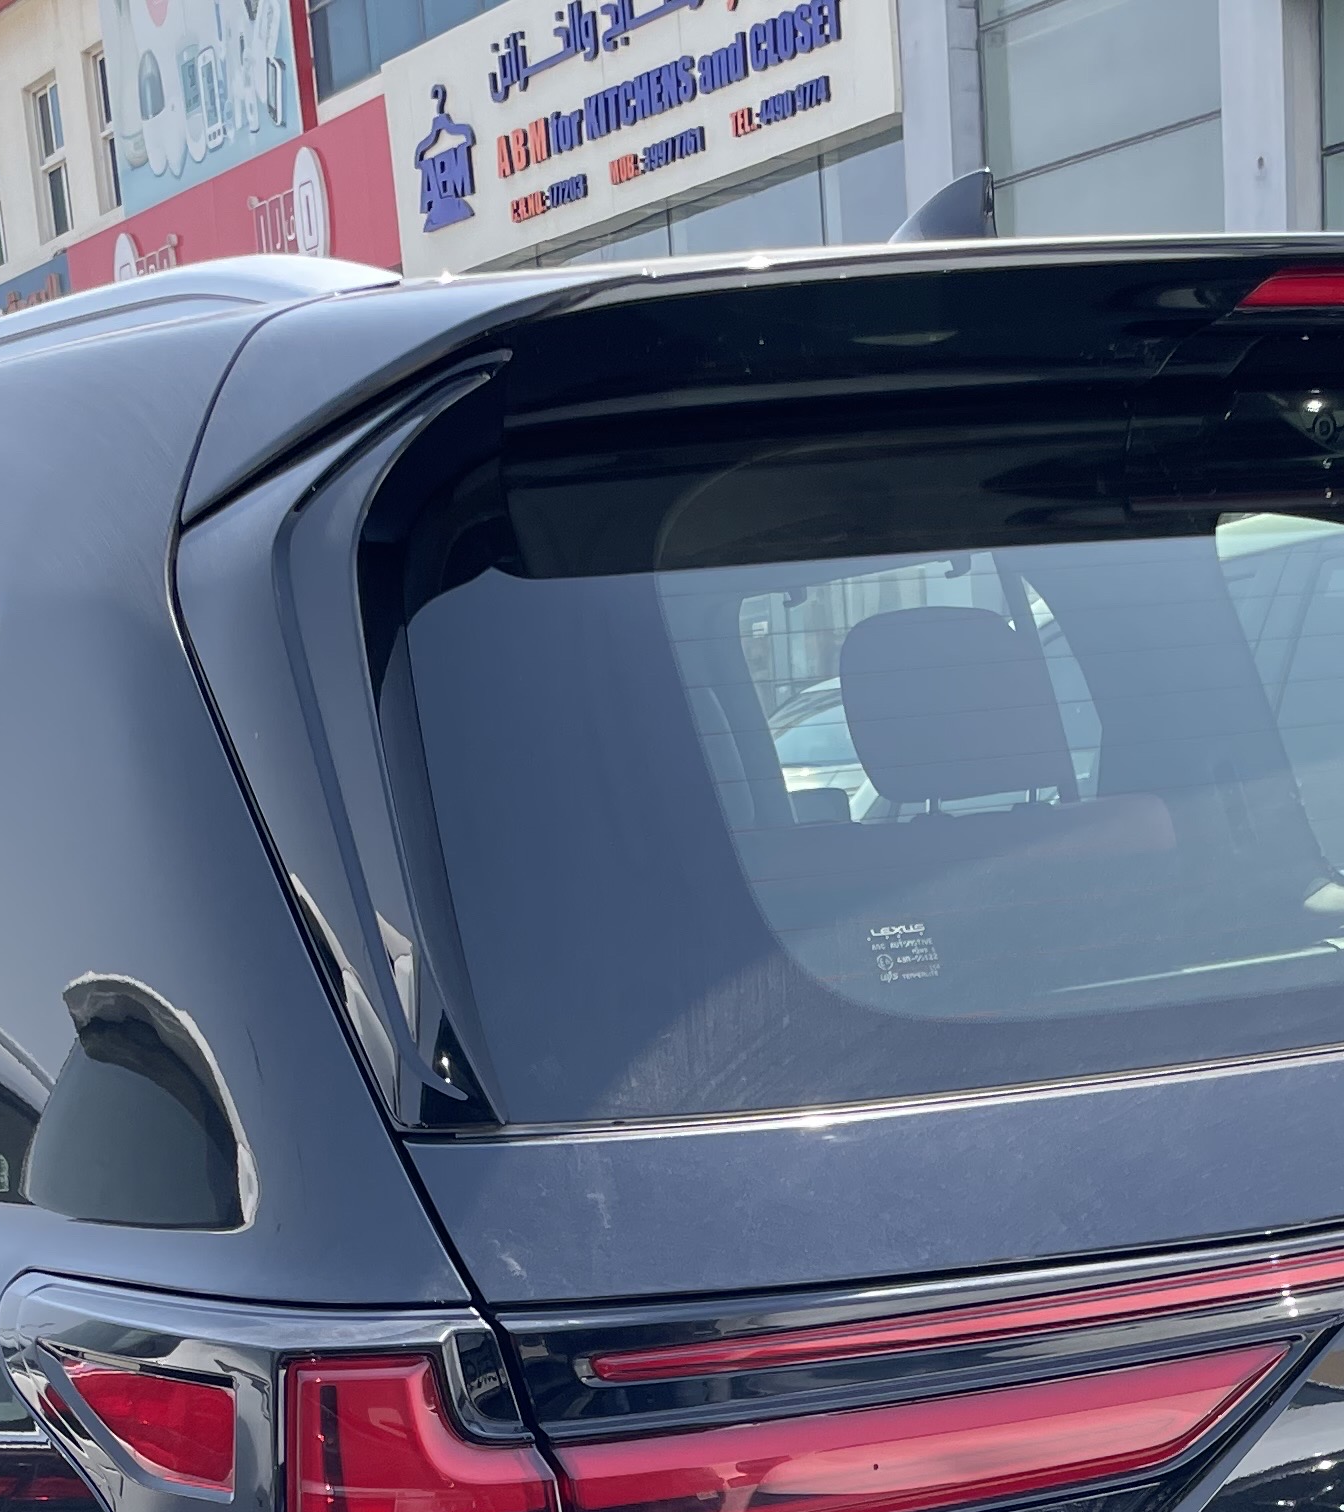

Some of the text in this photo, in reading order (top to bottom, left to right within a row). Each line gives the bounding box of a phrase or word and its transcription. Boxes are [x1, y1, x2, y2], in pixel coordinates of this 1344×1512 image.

[550, 109, 584, 156] for
[584, 55, 698, 144] KITCHENS
[697, 31, 750, 95] and
